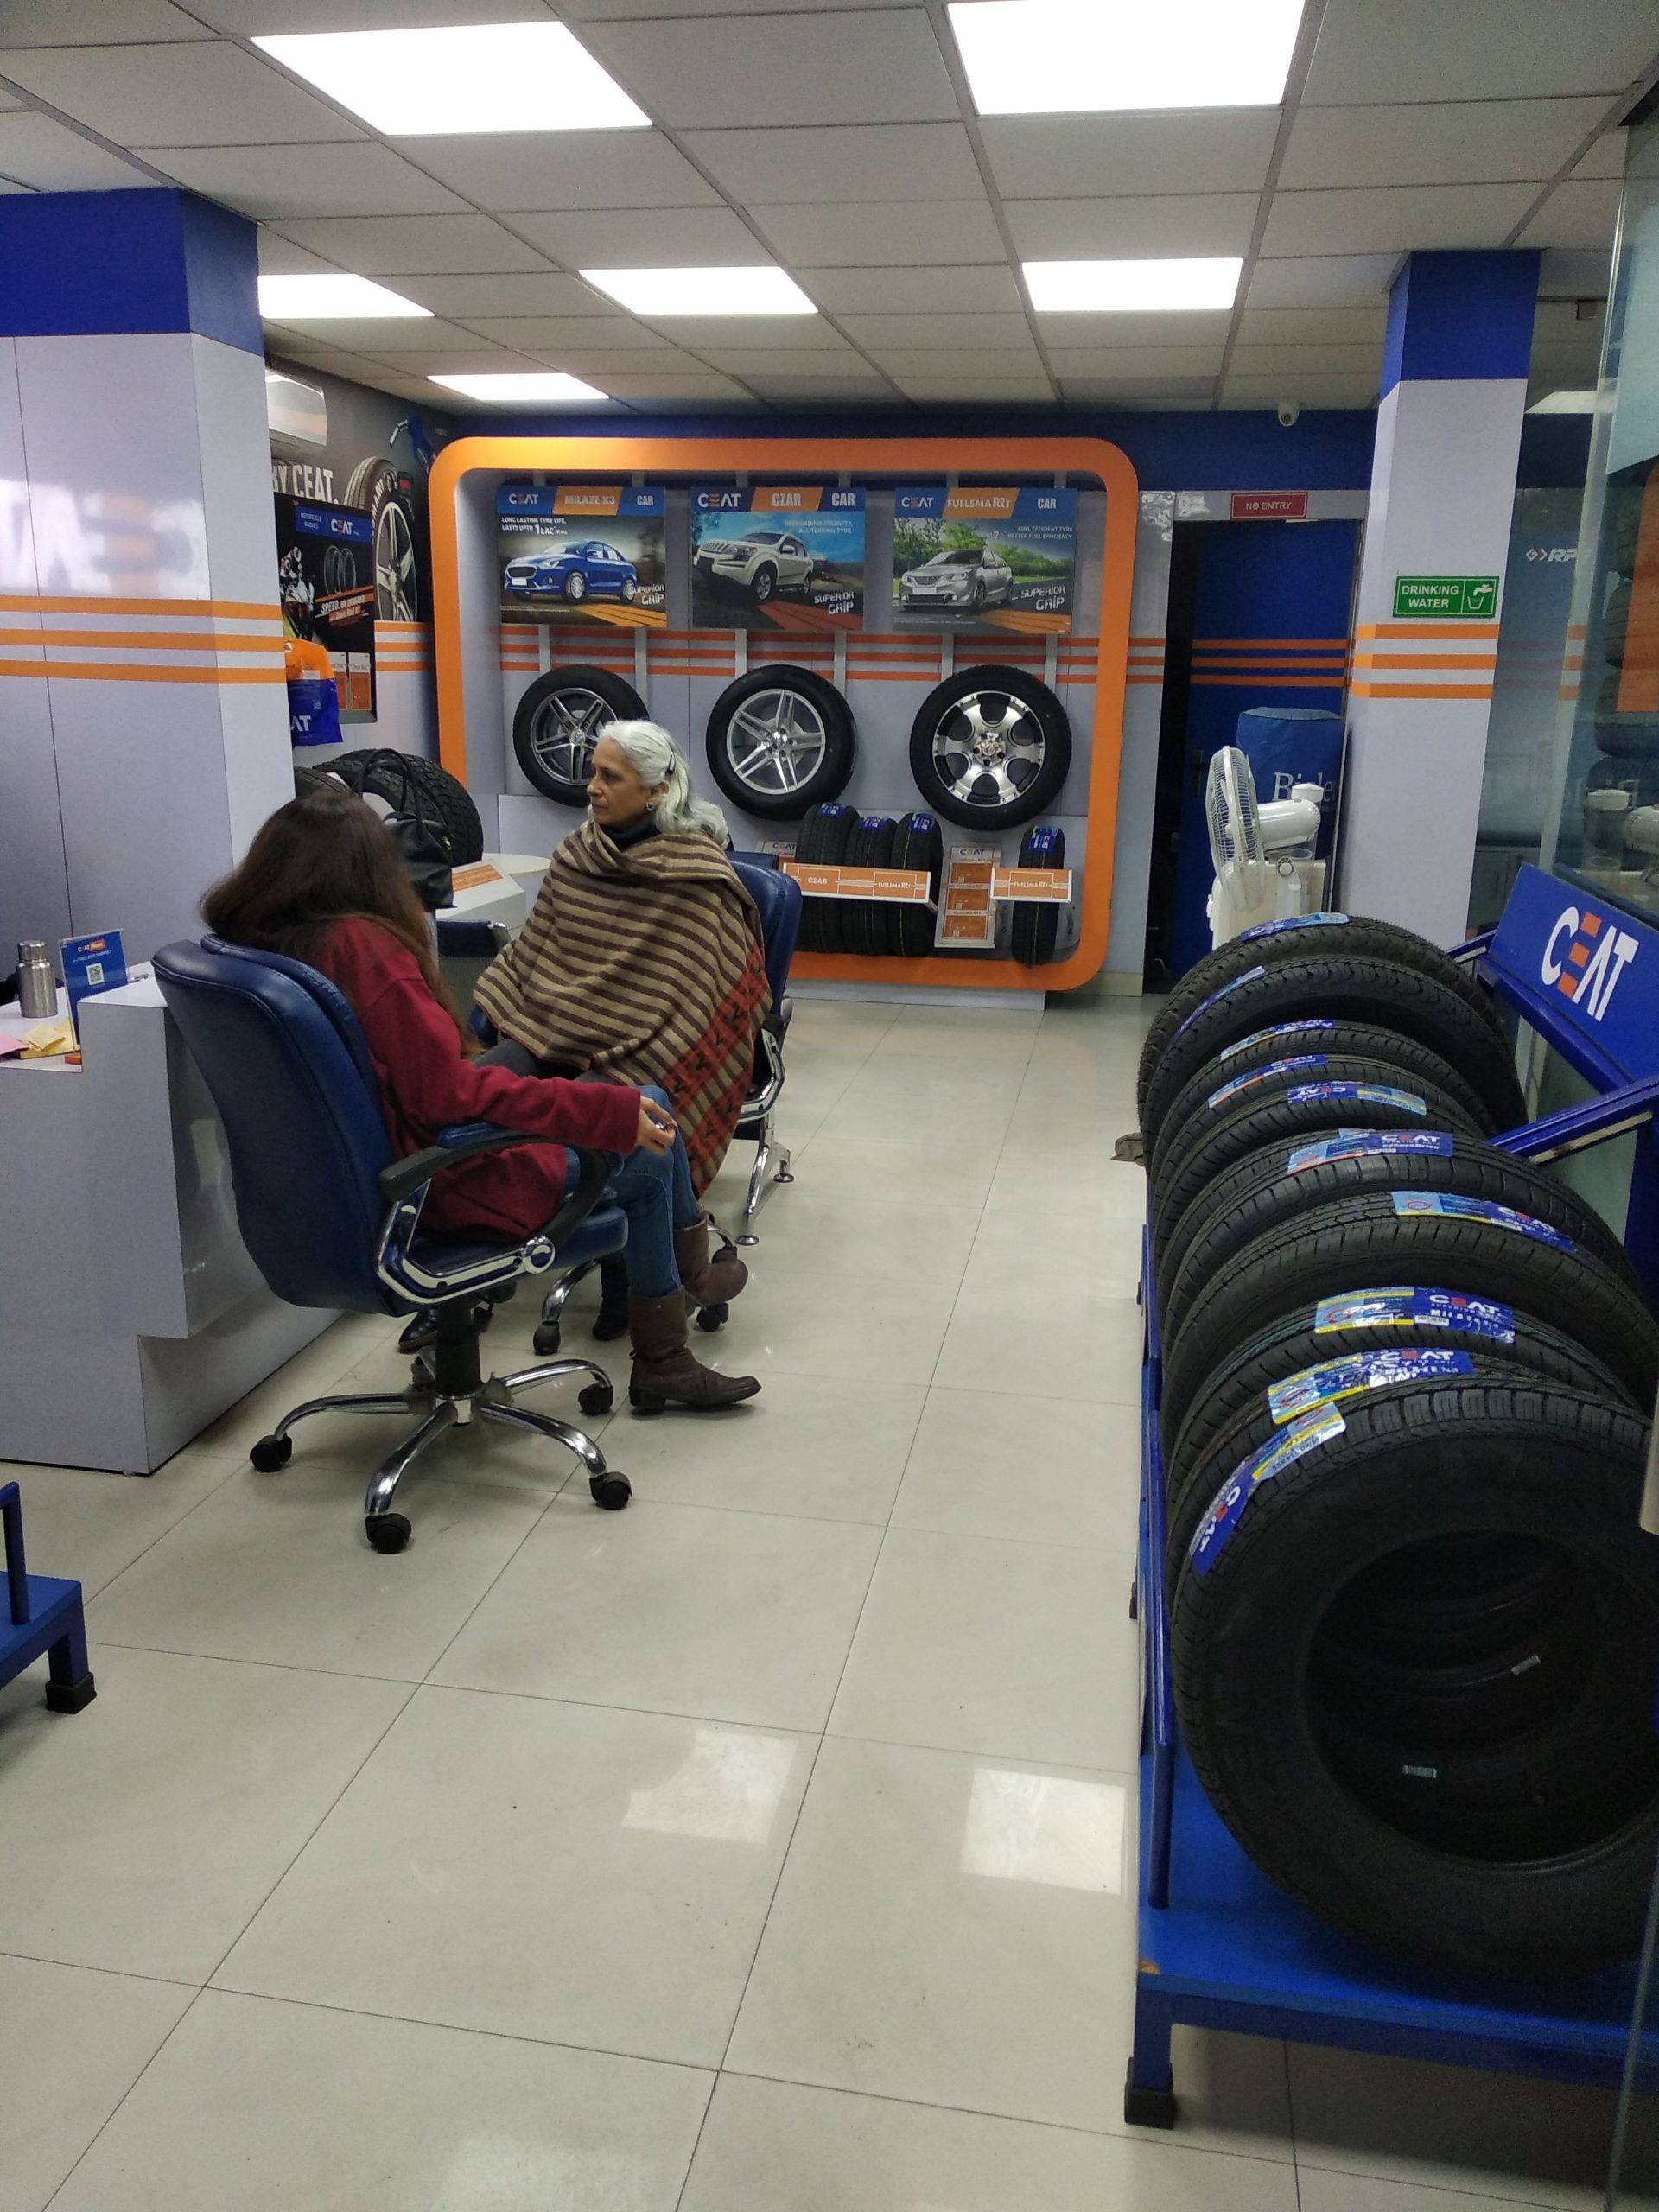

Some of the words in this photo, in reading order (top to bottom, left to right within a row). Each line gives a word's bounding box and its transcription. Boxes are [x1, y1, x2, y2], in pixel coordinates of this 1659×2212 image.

[508, 493, 540, 505] CEAT
[637, 495, 654, 507] CAR
[697, 493, 741, 508] CEAT
[772, 493, 802, 507] CZAR
[831, 493, 855, 507] CAR
[901, 497, 935, 508] CEAT
[1037, 498, 1057, 509] CAR
[1261, 501, 1293, 510] ENTRY
[330, 518, 353, 535] CEAT
[1021, 584, 1066, 599] SUPERIOR
[1402, 585, 1459, 595] DRINKING
[641, 593, 664, 605] GRIP
[814, 591, 855, 604] SUPERIOR
[1035, 595, 1065, 611] GRIP
[1408, 598, 1450, 608] WATER
[828, 601, 854, 614] GRIP
[1541, 906, 1639, 1022] CEAT
[1381, 1133, 1441, 1142] CEAT
[1429, 1294, 1500, 1314] CEAT
[1380, 1351, 1454, 1361] CEAT
